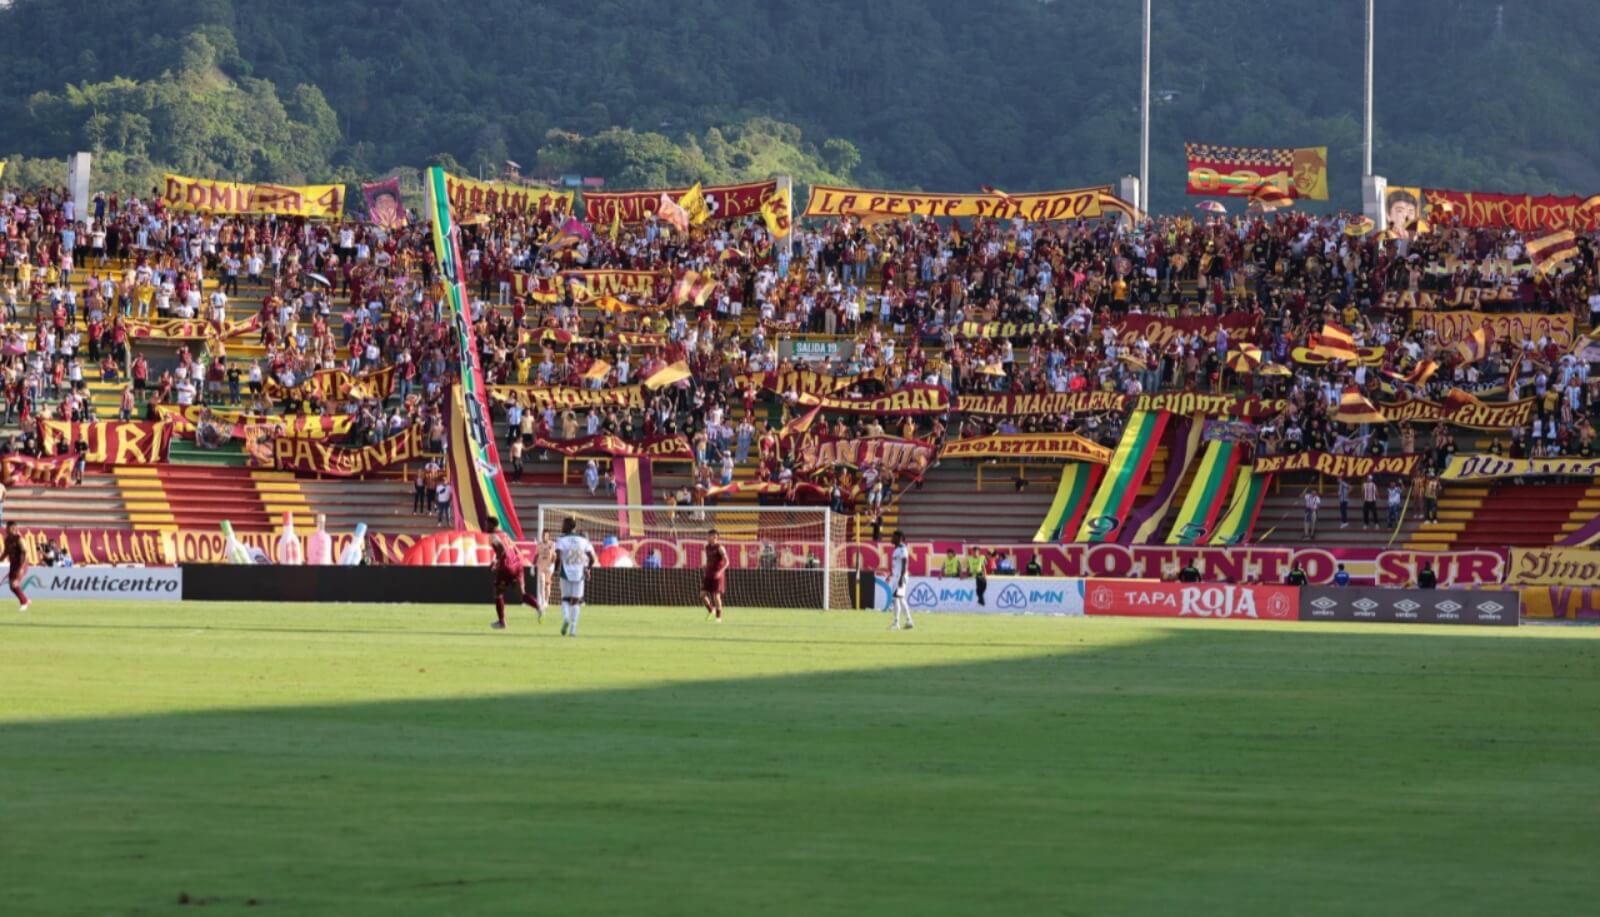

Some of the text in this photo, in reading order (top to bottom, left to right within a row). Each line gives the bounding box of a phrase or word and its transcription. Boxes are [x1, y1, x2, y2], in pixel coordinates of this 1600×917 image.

[820, 193, 855, 214] LA
[796, 342, 826, 353] SALIDA
[957, 395, 1008, 414] VILLA
[1013, 392, 1126, 414] MAGDALENA
[1284, 452, 1310, 470] LA
[1378, 552, 1499, 585] SUR
[51, 575, 178, 592] Multicentro
[940, 588, 973, 602] IMN
[1029, 590, 1064, 604] IMN
[1125, 584, 1258, 618] TAPA ROJA
